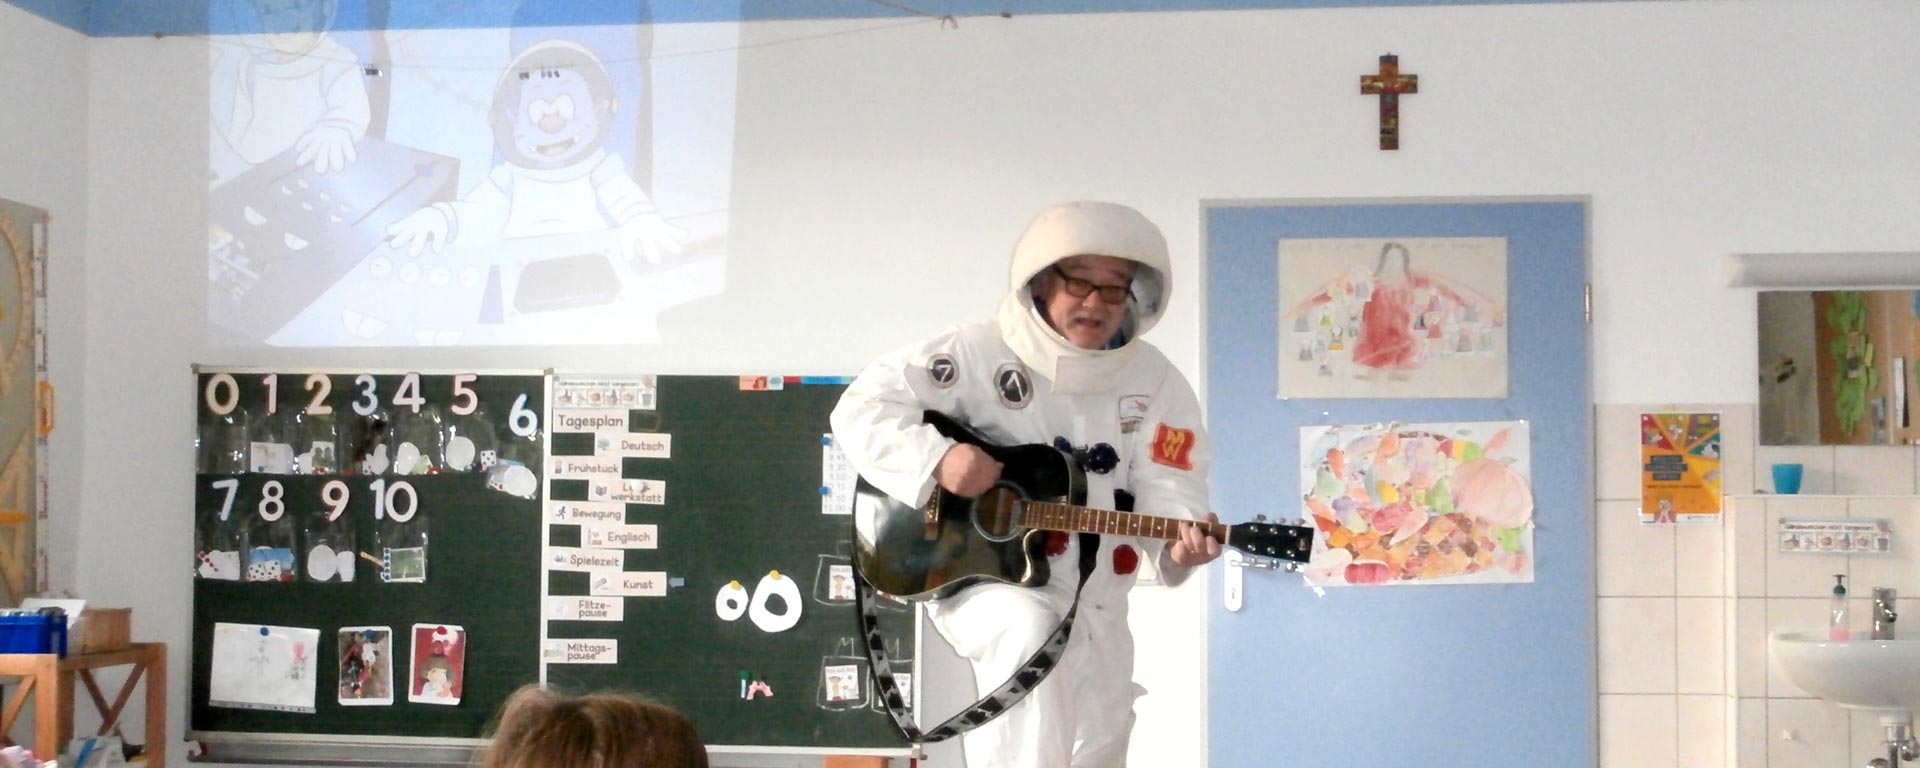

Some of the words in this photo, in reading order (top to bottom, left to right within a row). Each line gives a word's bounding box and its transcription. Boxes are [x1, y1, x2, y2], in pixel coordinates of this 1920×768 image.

[205, 373, 240, 416] 0
[262, 373, 278, 415] 1
[304, 374, 333, 415] 2
[352, 373, 379, 416] 3
[393, 372, 426, 414] 4
[451, 374, 478, 415] 5
[509, 393, 538, 437] 6
[558, 415, 623, 429] Tagesplan
[1166, 427, 1185, 445] M
[621, 441, 664, 451] Deutsch
[568, 463, 619, 473] Frühstück
[212, 479, 239, 521] 7
[258, 480, 285, 522] 8
[321, 479, 350, 522] 9
[370, 478, 418, 522] 10
[611, 492, 662, 503] werkstatt
[572, 508, 622, 520] Bewegung
[607, 531, 651, 544] Englisch
[570, 554, 619, 567] Spielezeit
[623, 580, 653, 589] Kunst
[579, 600, 611, 609] Flitze-
[579, 609, 607, 618] pause
[567, 643, 611, 655] Mittags-
[567, 651, 596, 662] pause
